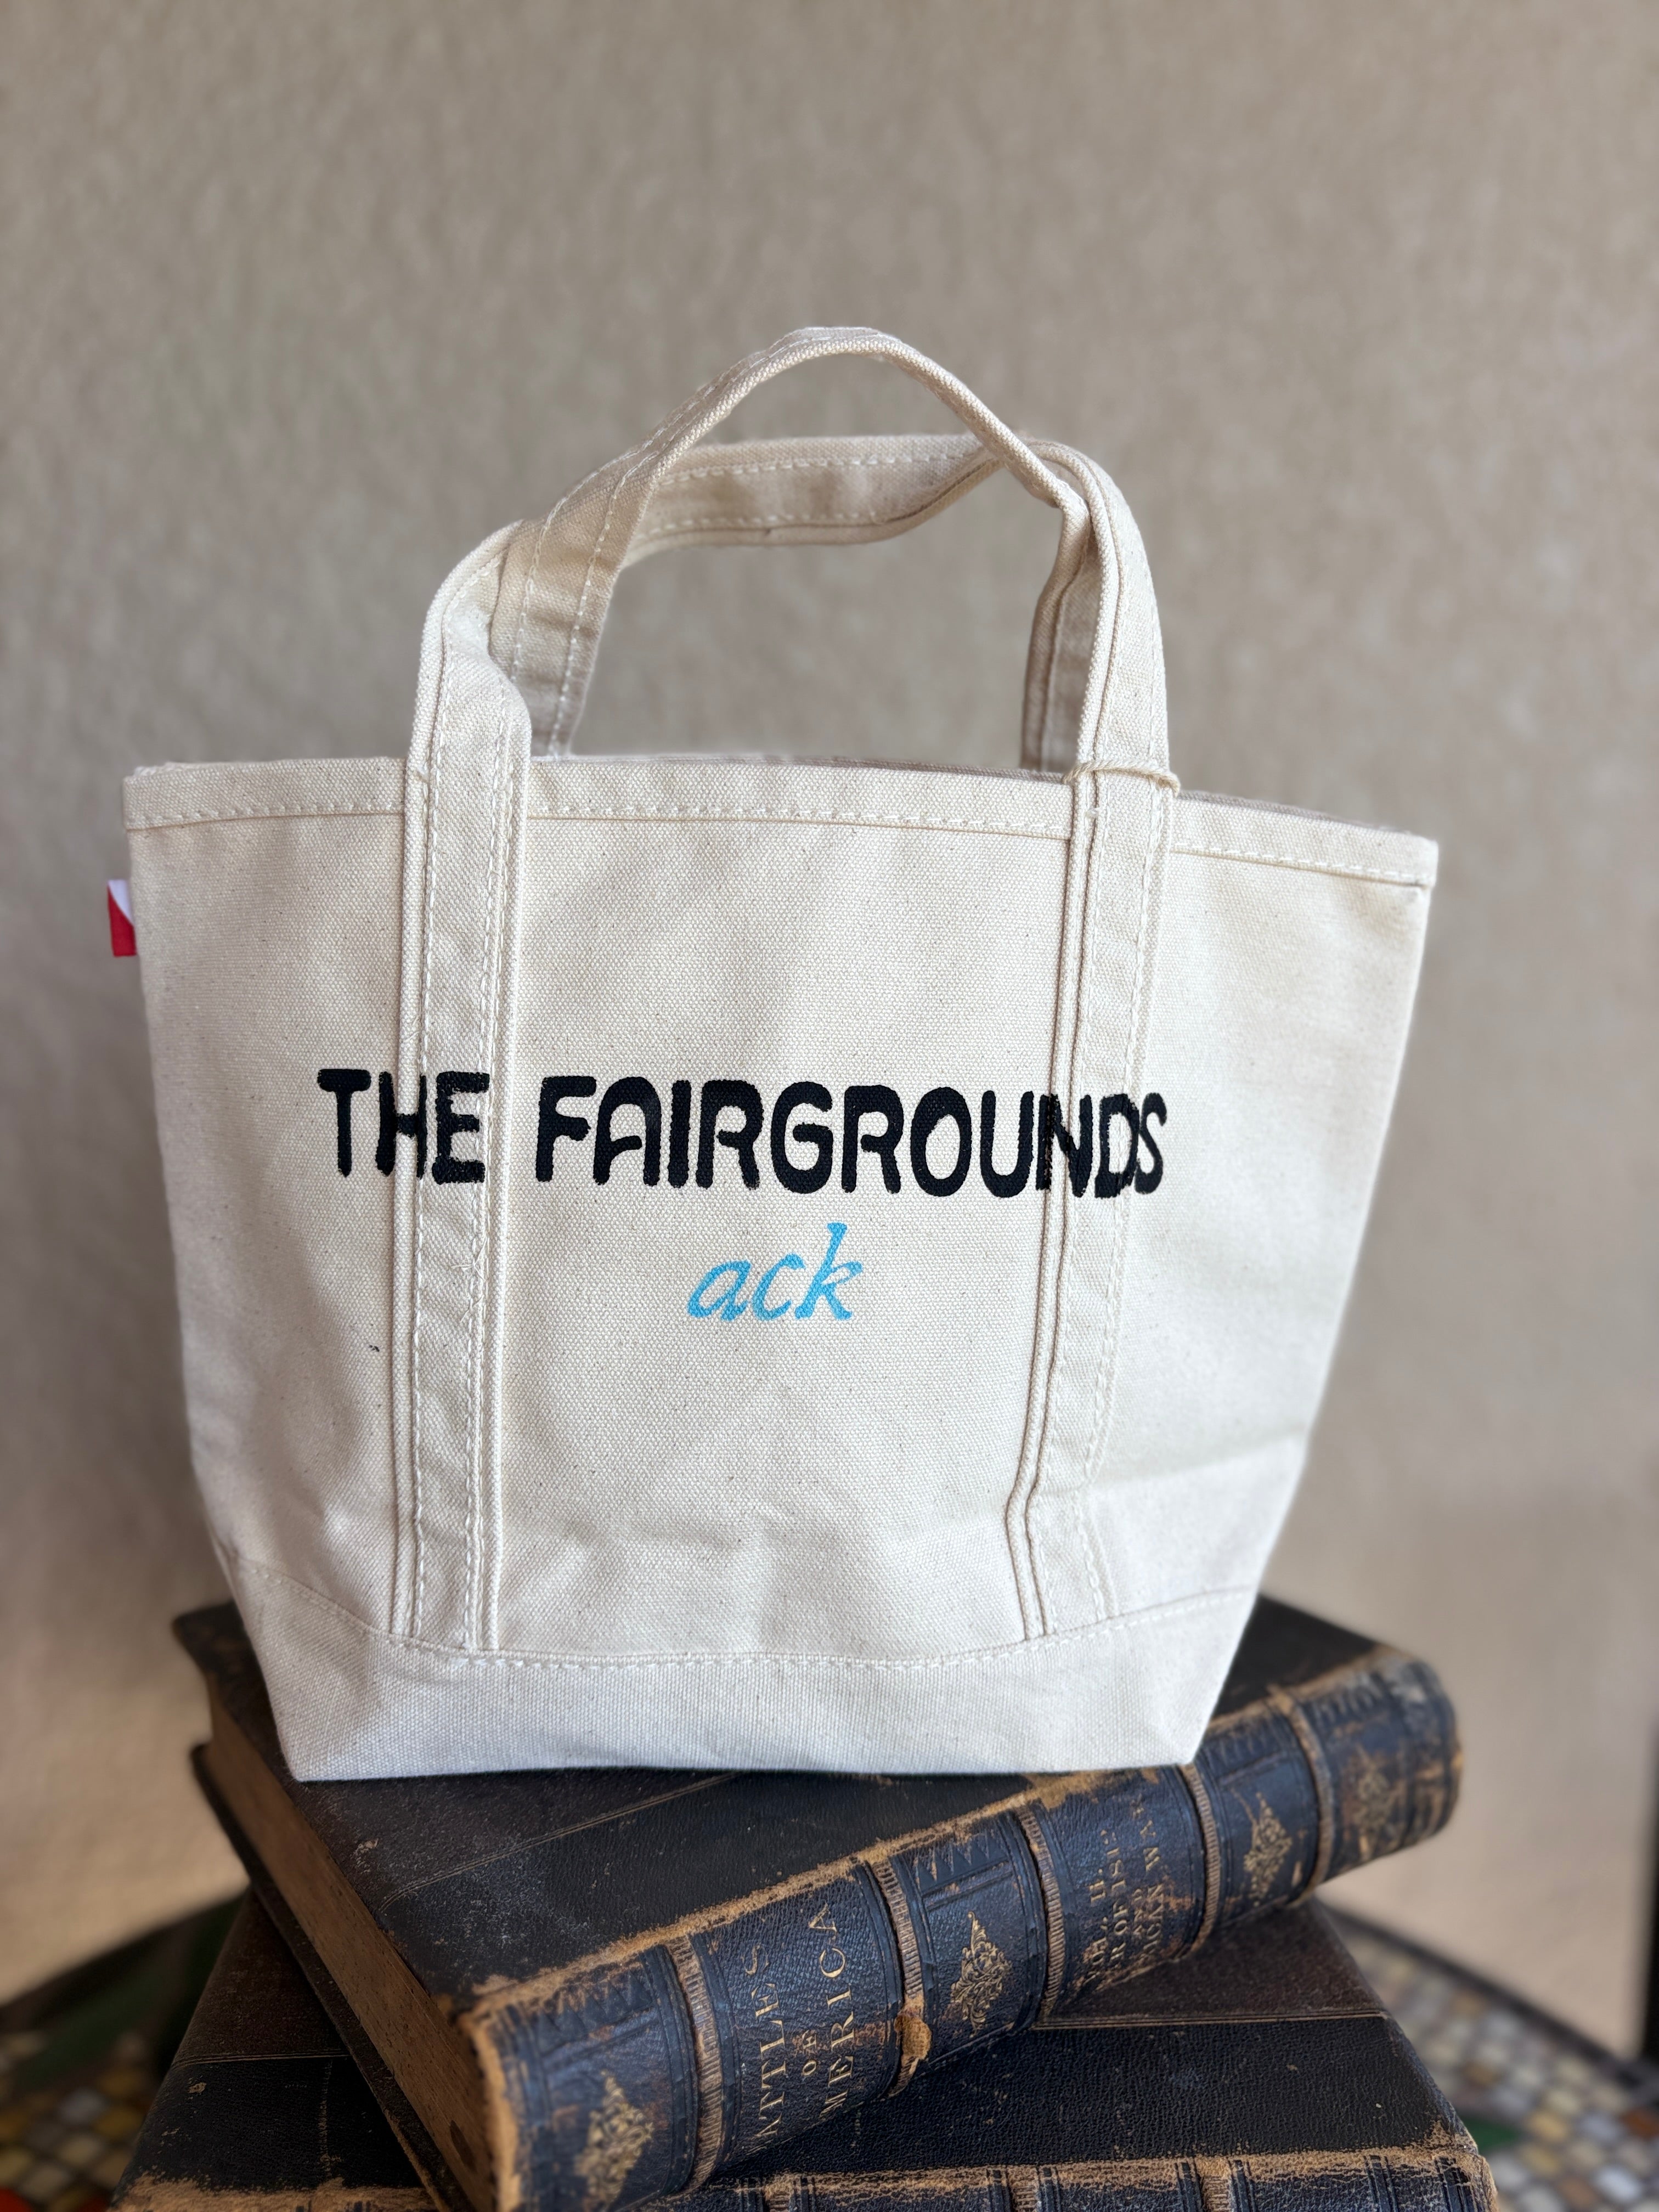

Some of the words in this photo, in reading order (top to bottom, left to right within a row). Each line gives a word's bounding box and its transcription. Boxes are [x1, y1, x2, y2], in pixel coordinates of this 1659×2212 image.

[317, 1068, 490, 1185] THE
[535, 1075, 1167, 1199] FAIRGROUNDS
[687, 1222, 863, 1321] ack
[1113, 1898, 1128, 1937] OF
[742, 1944, 786, 2157] ATTLES
[802, 2029, 817, 2076] OF
[808, 1901, 855, 2119] MERICA
